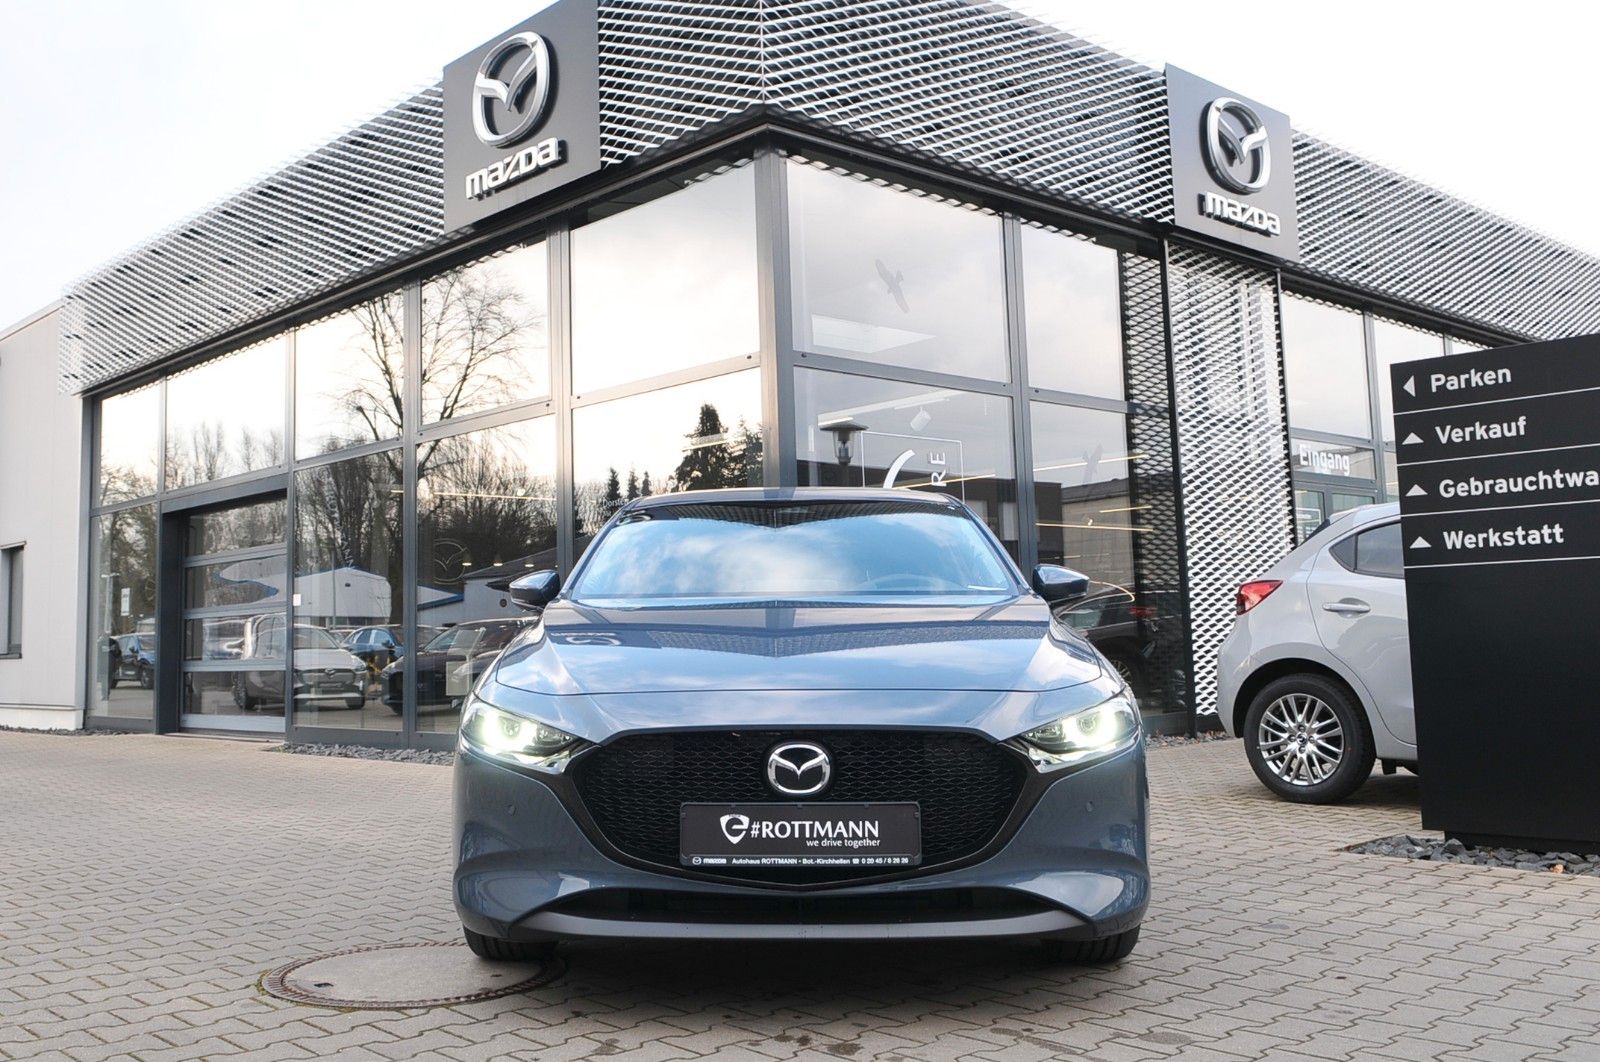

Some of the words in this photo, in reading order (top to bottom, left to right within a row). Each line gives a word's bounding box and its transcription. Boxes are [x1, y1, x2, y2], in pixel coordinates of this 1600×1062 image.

[465, 137, 559, 199] mazda
[1205, 191, 1280, 236] mazda
[1430, 368, 1512, 393] Parken
[1435, 416, 1527, 444] Verkauf
[1299, 443, 1350, 476] Eingang
[1439, 469, 1600, 498] Gebrauchtwa
[1443, 523, 1565, 550] Werkstatt
[750, 821, 879, 839] #ROTTMANN
[806, 839, 819, 847] we
[821, 838, 843, 847] drive
[844, 838, 881, 849] together
